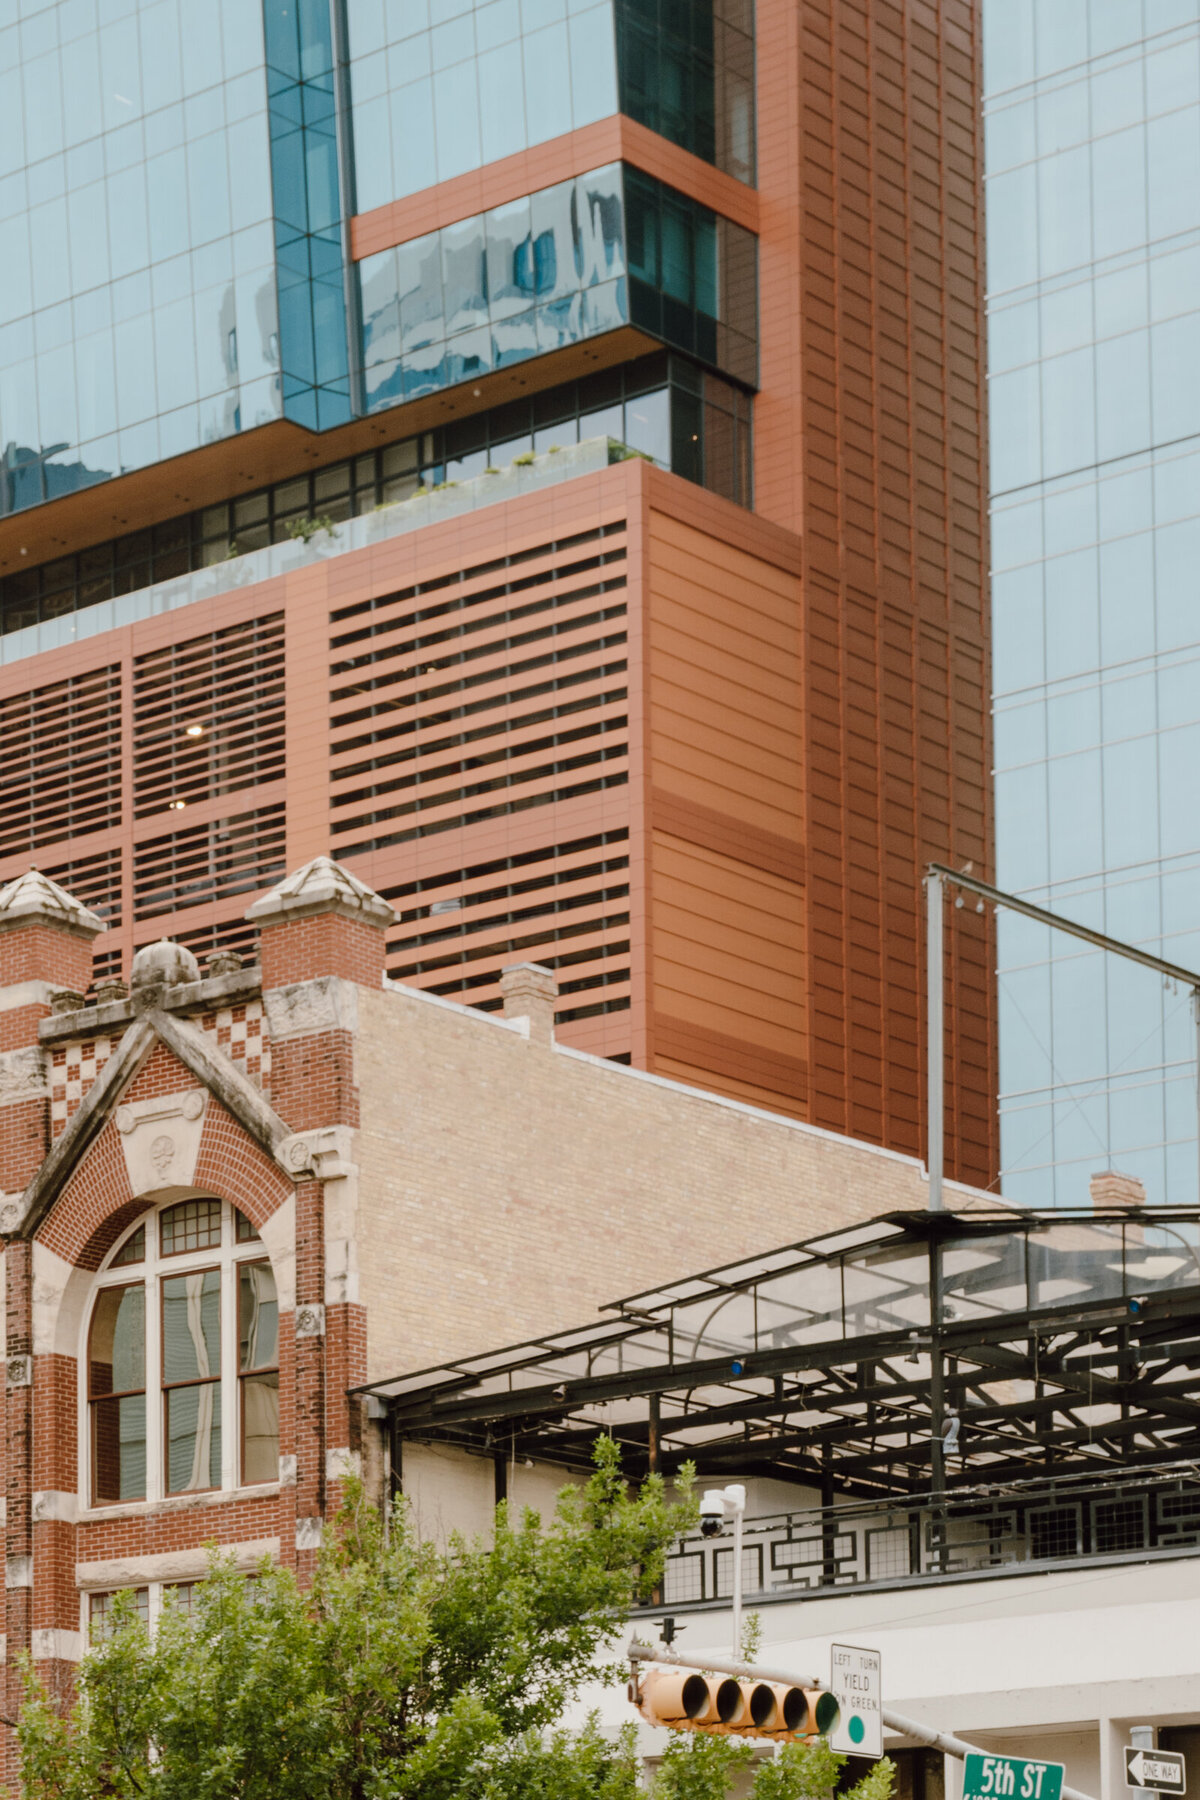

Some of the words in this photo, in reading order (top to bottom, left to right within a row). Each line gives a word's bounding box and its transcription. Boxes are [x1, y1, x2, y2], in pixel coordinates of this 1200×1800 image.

[834, 1653, 851, 1666] LEFT
[860, 1656, 878, 1670] TURN
[843, 1673, 870, 1692] YIELD
[980, 1758, 1015, 1796] 5th
[1020, 1763, 1047, 1799] ST
[1143, 1762, 1159, 1778] ONE
[1161, 1764, 1178, 1780] WAY
